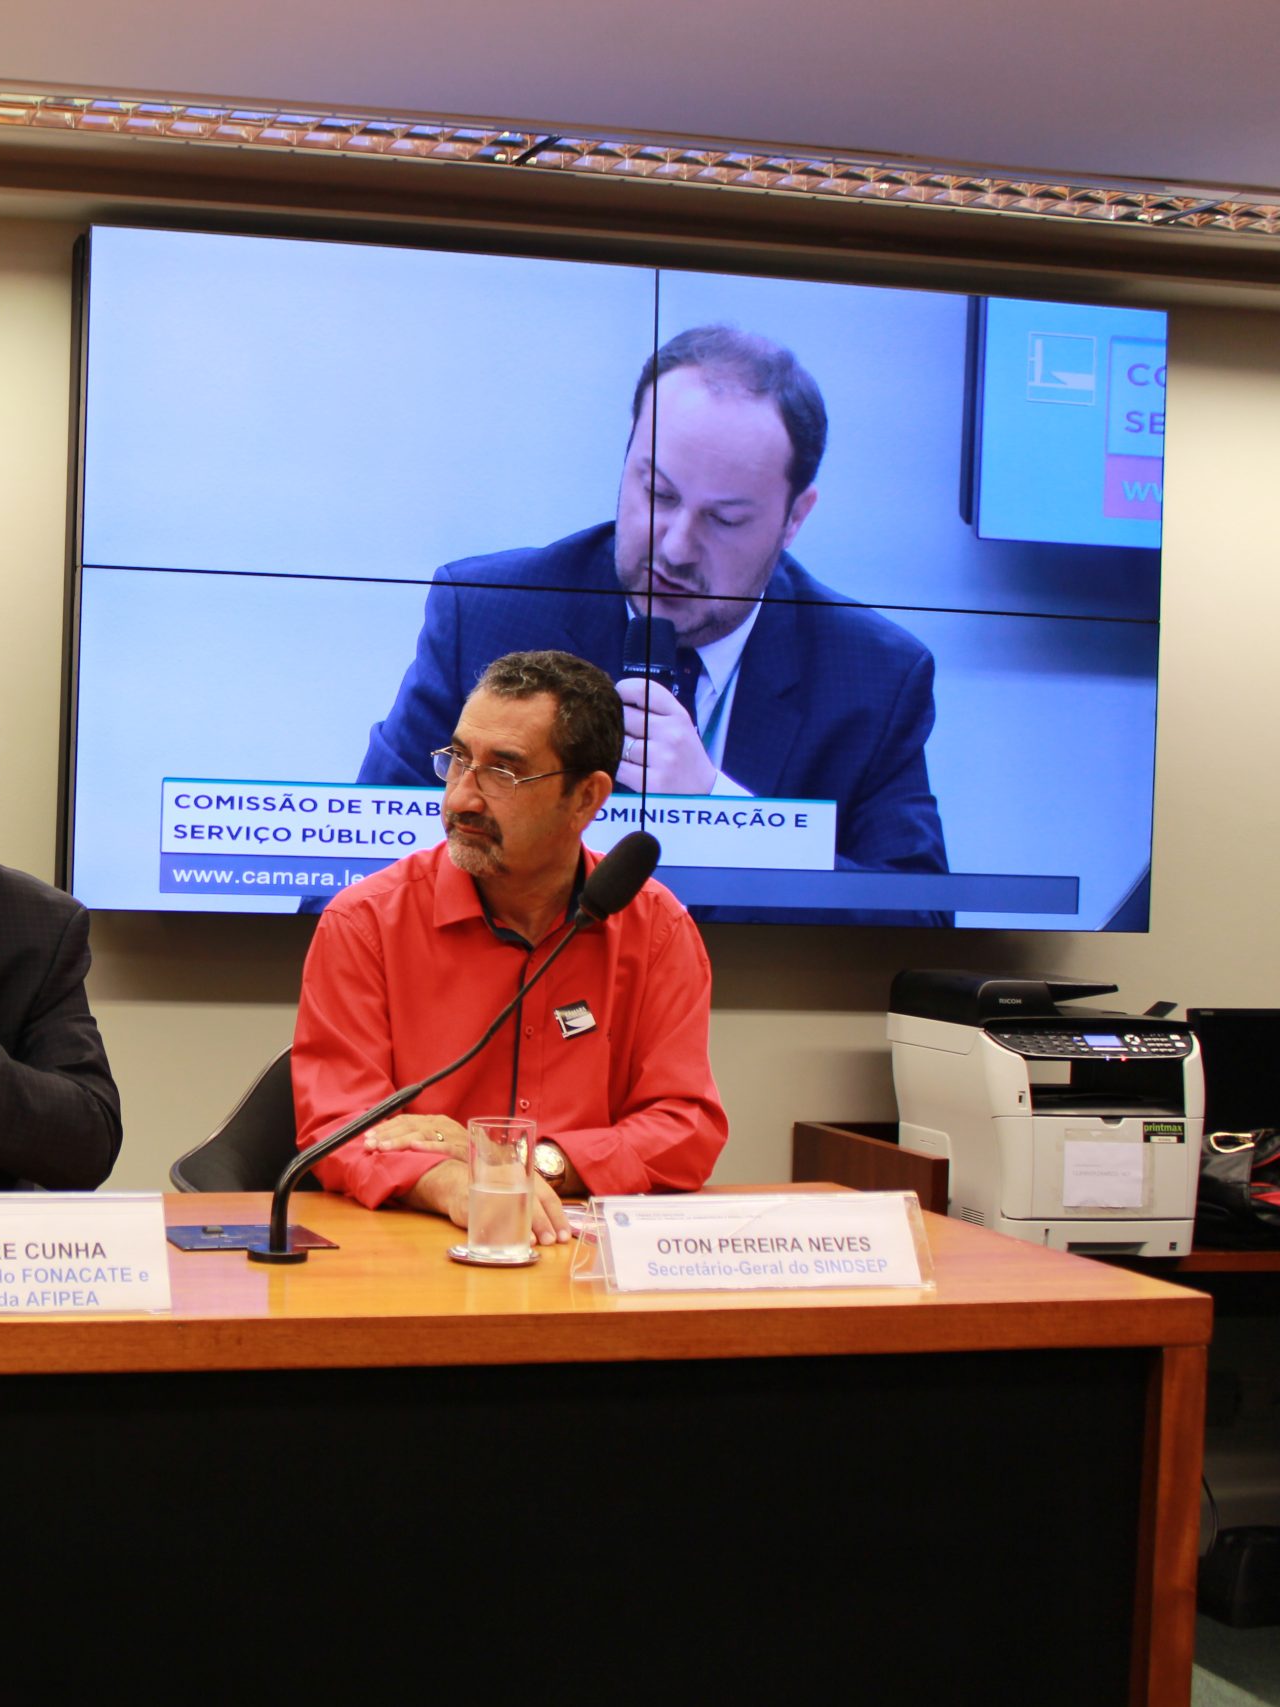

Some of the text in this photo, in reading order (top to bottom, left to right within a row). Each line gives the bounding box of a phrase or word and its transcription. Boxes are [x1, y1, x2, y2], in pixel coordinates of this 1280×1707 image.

[1124, 411, 1165, 435] SE
[174, 793, 318, 813] COMISSÃO
[328, 799, 362, 815] DE
[794, 813, 808, 828] E
[173, 824, 417, 845] SERVIÇO PÚBLICO
[1144, 1122, 1183, 1132] printmax
[24, 1242, 107, 1260] CUNHA
[657, 1236, 871, 1255] OTON PEREIRA NEVES
[21, 1267, 132, 1284] FONACATE
[138, 1271, 149, 1283] e
[647, 1259, 888, 1277] Secretário-Geral do SINDSEP
[25, 1291, 100, 1307] AFIPEA
